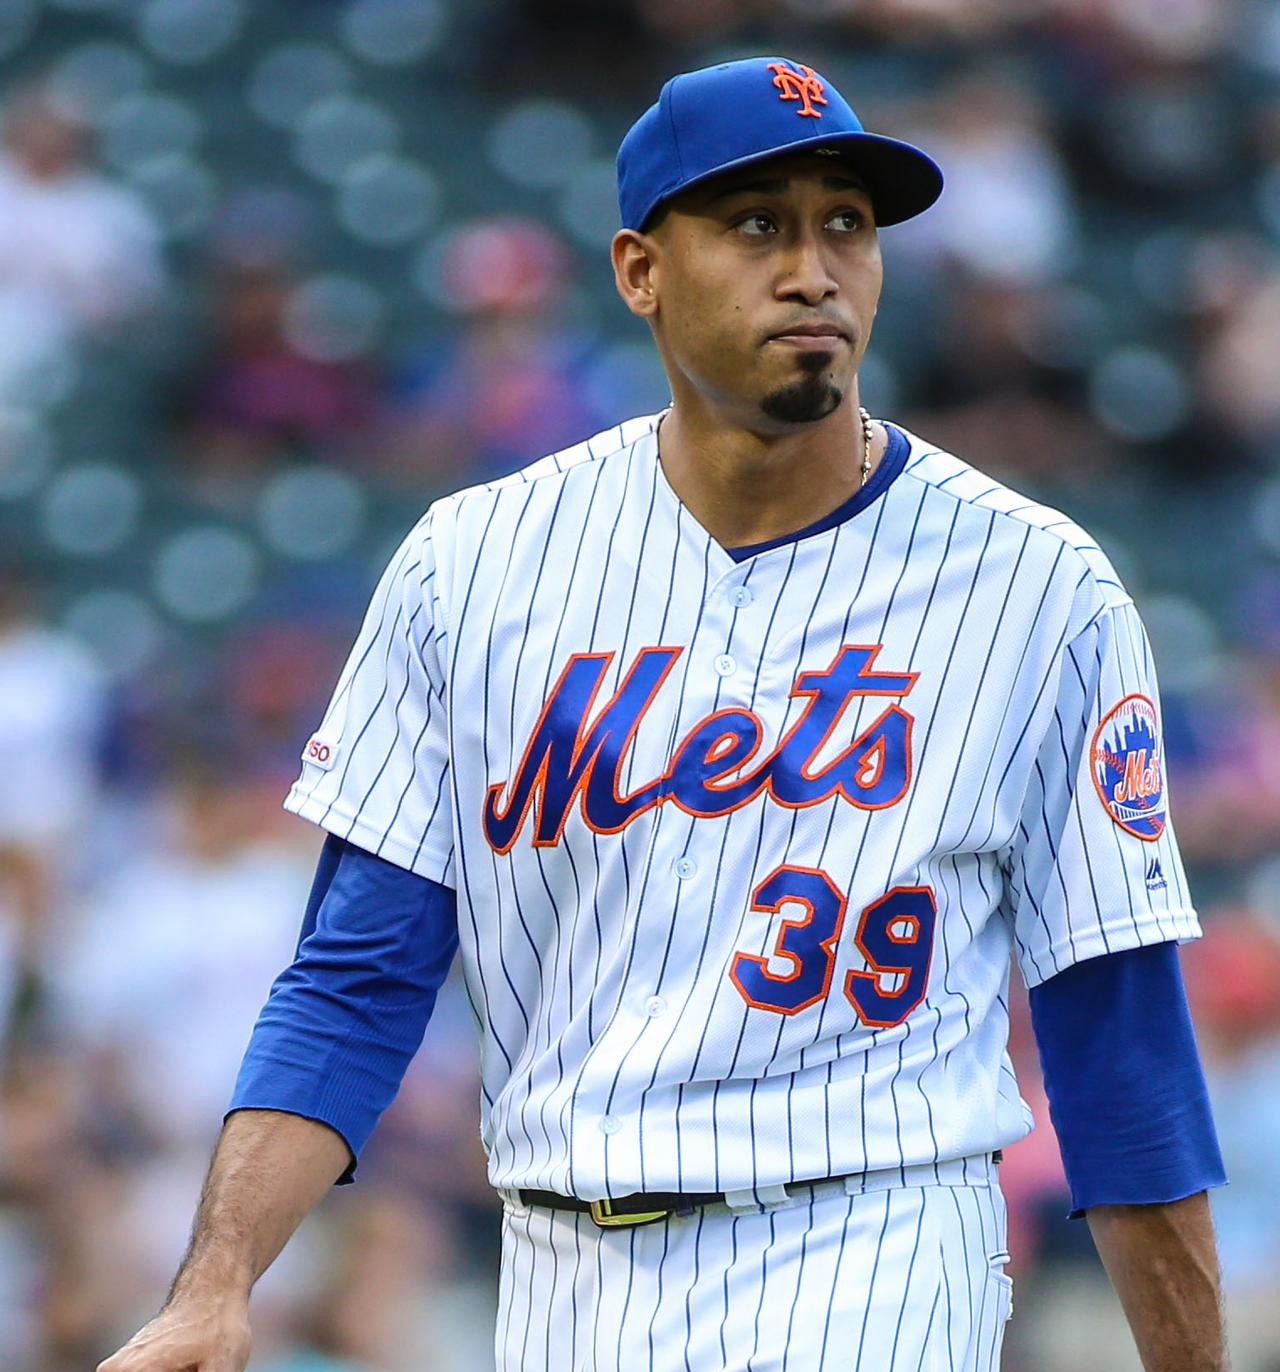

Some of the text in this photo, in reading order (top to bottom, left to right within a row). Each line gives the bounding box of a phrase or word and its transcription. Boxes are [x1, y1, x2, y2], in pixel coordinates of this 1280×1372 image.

[767, 63, 827, 118] NY
[483, 643, 921, 856] Mets
[728, 863, 938, 1029] 39
